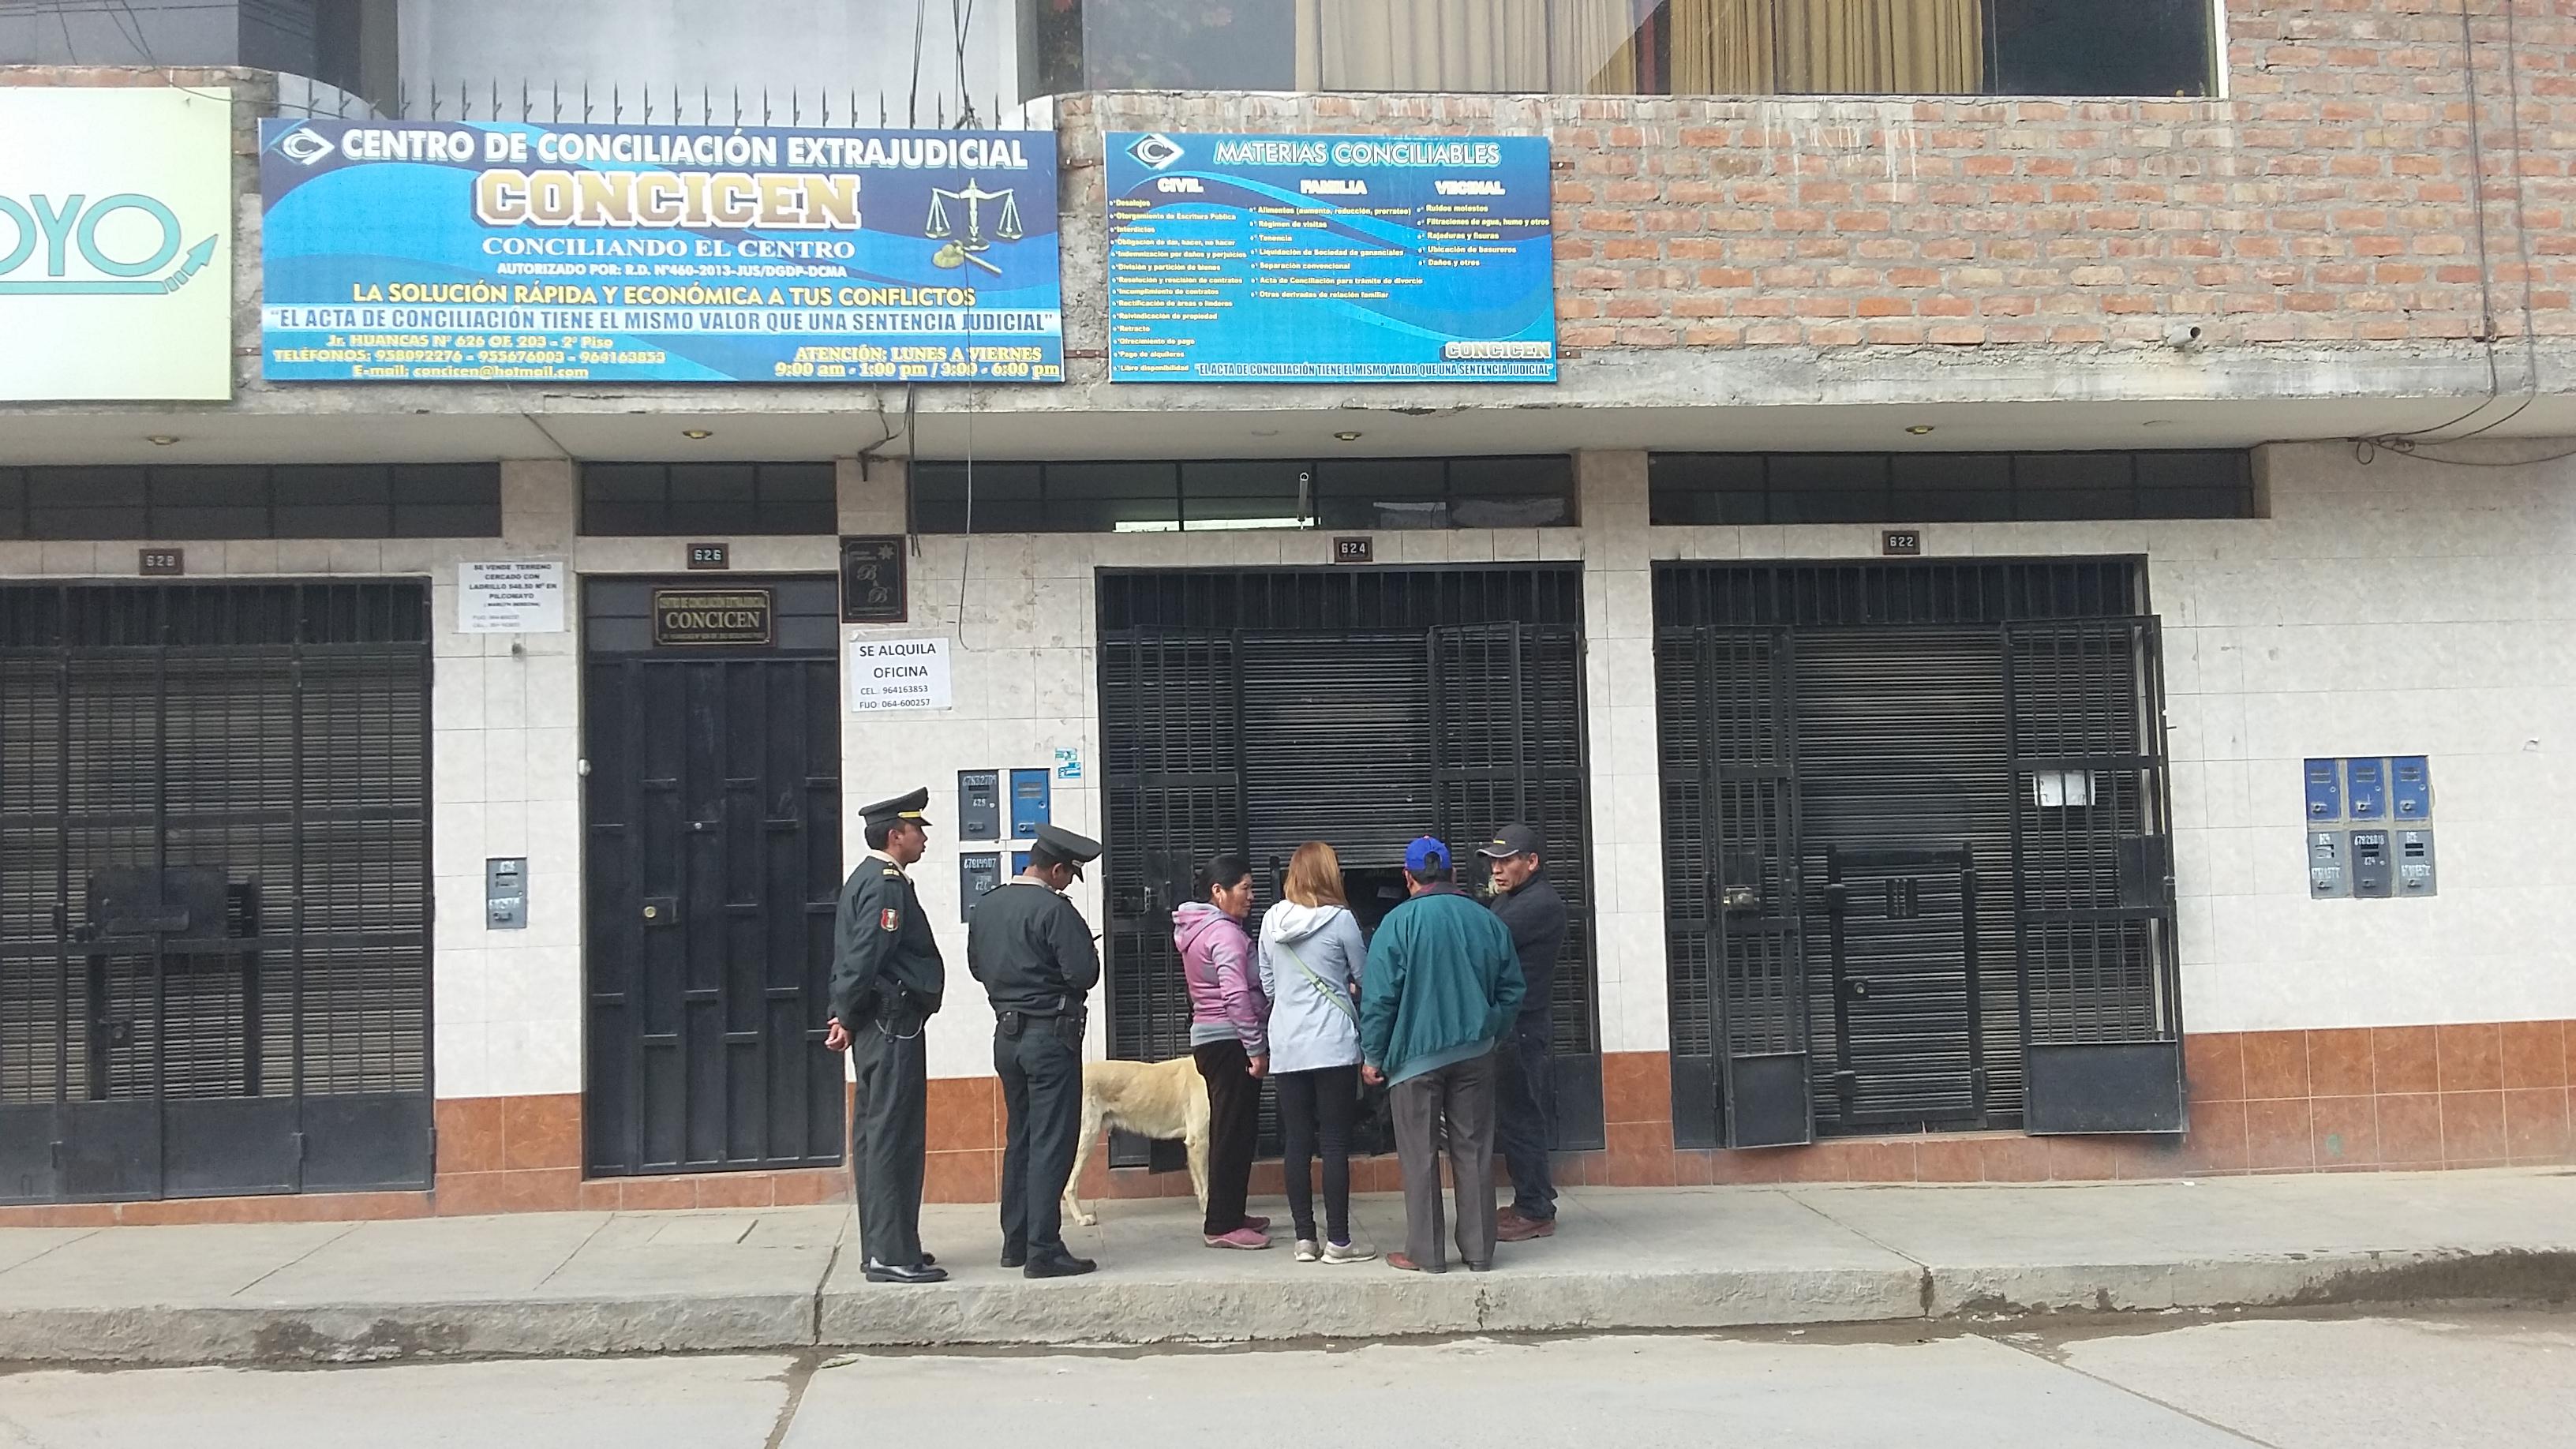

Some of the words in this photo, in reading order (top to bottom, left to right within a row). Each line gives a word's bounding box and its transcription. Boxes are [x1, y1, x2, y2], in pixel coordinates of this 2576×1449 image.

[342, 129, 474, 161] CENTRO
[485, 133, 527, 162] DE
[538, 129, 777, 165] CONCILIACIÓN
[788, 137, 1028, 169] EXTRAJUDICIAL
[1215, 142, 1327, 164] MATERIAS
[1334, 144, 1500, 166] CONCILIABLES
[1157, 178, 1204, 193] CIVIL
[1300, 180, 1367, 195] FAMILIA
[474, 169, 861, 230] CONCICEN
[483, 238, 687, 256] CONCILIANDO
[695, 240, 731, 257] EL
[738, 240, 855, 258] CENTRO
[497, 263, 586, 275] AUTORIZADO
[589, 264, 621, 276] POR:
[625, 264, 650, 276] R.D.
[354, 283, 383, 303] LA
[389, 280, 507, 303] SOLUCIÓN
[514, 280, 597, 304] RÁPIDA
[603, 286, 617, 304] Y
[624, 281, 762, 306] ECONÓMICA
[768, 287, 784, 306] A
[790, 288, 832, 307] TUS
[839, 287, 975, 307] CONFLICTOS
[305, 309, 355, 327] ACTA
[363, 310, 385, 328] DE
[392, 307, 535, 328] CONCILIACIÓN
[542, 310, 593, 329] TIENE
[601, 311, 618, 329] EL
[625, 311, 691, 329] MISMO
[700, 312, 760, 330] VALOR
[767, 312, 803, 332] QUE
[810, 313, 846, 330] UNA
[853, 313, 957, 331] SENTENCIA
[328, 334, 345, 347] Jr.
[349, 334, 429, 347] HUANCAS
[455, 335, 485, 348] 626
[517, 336, 547, 348] 203
[580, 336, 613, 349] Piso
[273, 349, 371, 362] TELÉFONOS:
[375, 350, 463, 362] 958092276
[478, 350, 564, 363] 955676003
[579, 350, 665, 365] 964163853
[794, 346, 887, 364] ATENCIÓN:
[890, 347, 947, 364] LUNES
[950, 347, 965, 364] A
[969, 347, 1041, 364] VIERNES
[1445, 341, 1552, 359] CONCICEN
[353, 364, 409, 378] E-mail:
[775, 360, 814, 377] 9:00
[817, 360, 846, 377] am
[859, 360, 896, 377] 1:00
[899, 360, 928, 380] pm
[940, 360, 978, 377] 3:00
[991, 360, 1029, 377] 6:00
[1032, 360, 1060, 380] pm
[1211, 365, 1234, 375] ACTA
[1237, 365, 1248, 375] DE
[1251, 363, 1314, 375] CONCILIACIÓN
[1317, 365, 1342, 375] TIENE
[1343, 365, 1354, 375] EL
[1355, 365, 1387, 375] MISMO
[1389, 365, 1417, 375] VALOR
[1419, 365, 1437, 376] QUE
[1439, 365, 1457, 376] UNA
[1459, 365, 1508, 376] SENTENCIA
[1342, 543, 1366, 553] 624
[1890, 536, 1913, 547] 622
[694, 549, 721, 560] 626
[665, 612, 761, 629] CONCICEN
[859, 646, 874, 657] SE
[878, 643, 937, 657] ALQUILA
[873, 665, 928, 678] OFICINA
[882, 685, 929, 694] 964163853
[882, 699, 930, 708] 064-600257
